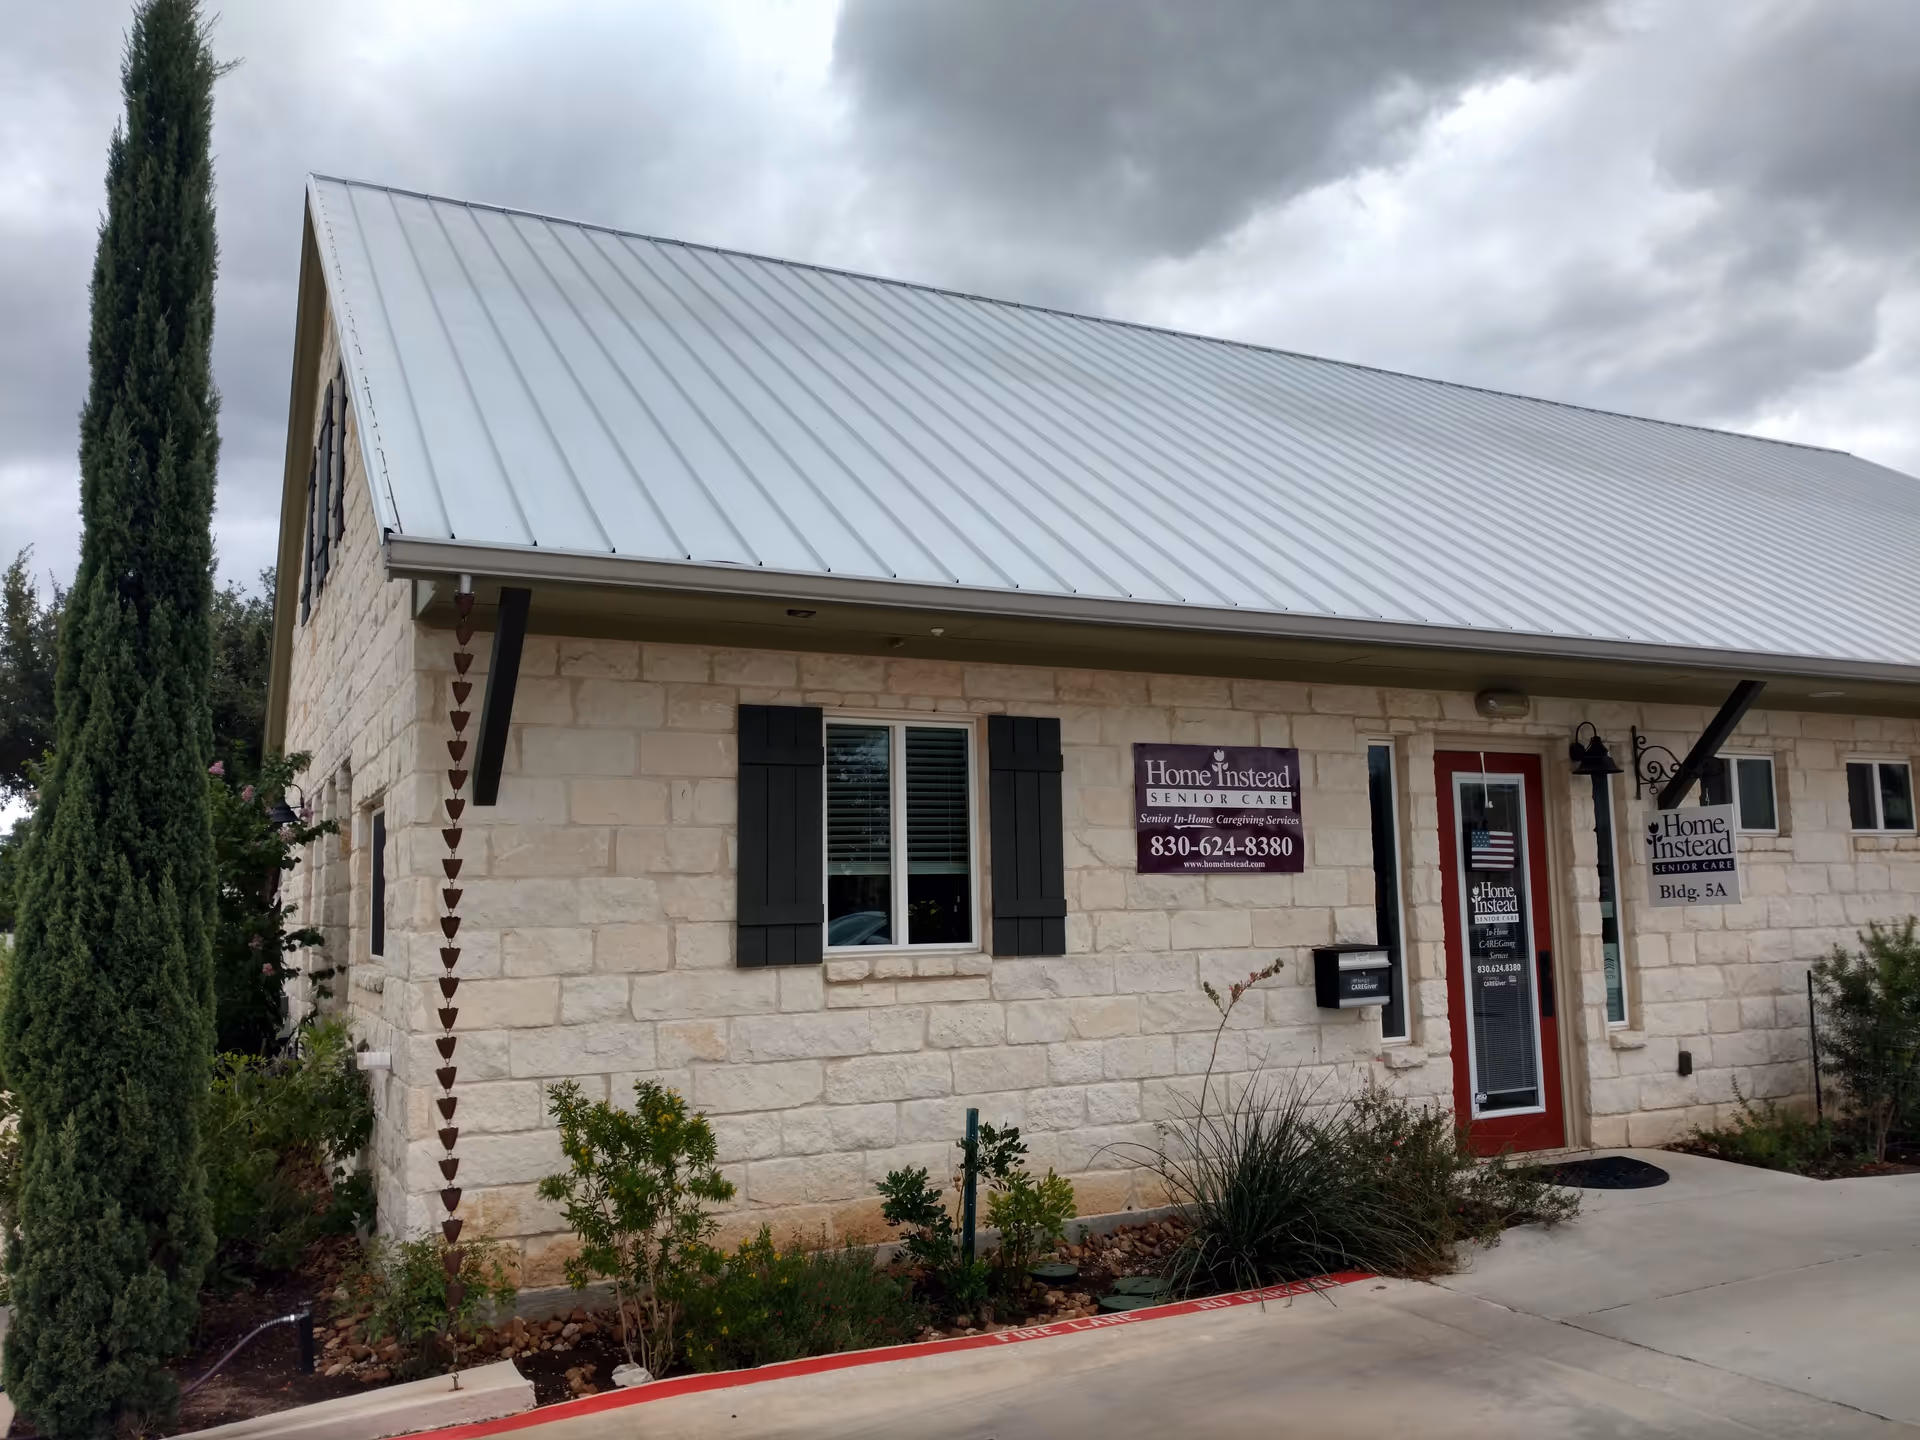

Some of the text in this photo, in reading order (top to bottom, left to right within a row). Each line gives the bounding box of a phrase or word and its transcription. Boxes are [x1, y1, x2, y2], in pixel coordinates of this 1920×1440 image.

[1145, 759, 1291, 788] Home Instead
[1151, 792, 1289, 805] SENIOR CARE
[1140, 813, 1299, 826] Senior In-Home Caregiving Services
[1661, 813, 1726, 838] Home
[1150, 835, 1293, 857] 830-624-8380
[1652, 830, 1733, 859] Instead
[1655, 860, 1732, 873] SENIOR CARE
[1480, 881, 1515, 898] Home
[1659, 882, 1728, 903] Bldg. 5A
[1474, 895, 1519, 913] Instead
[1477, 963, 1521, 974] 830.624.8380
[1194, 1299, 1232, 1310] NO
[993, 1313, 1142, 1342] FIRE LANE
